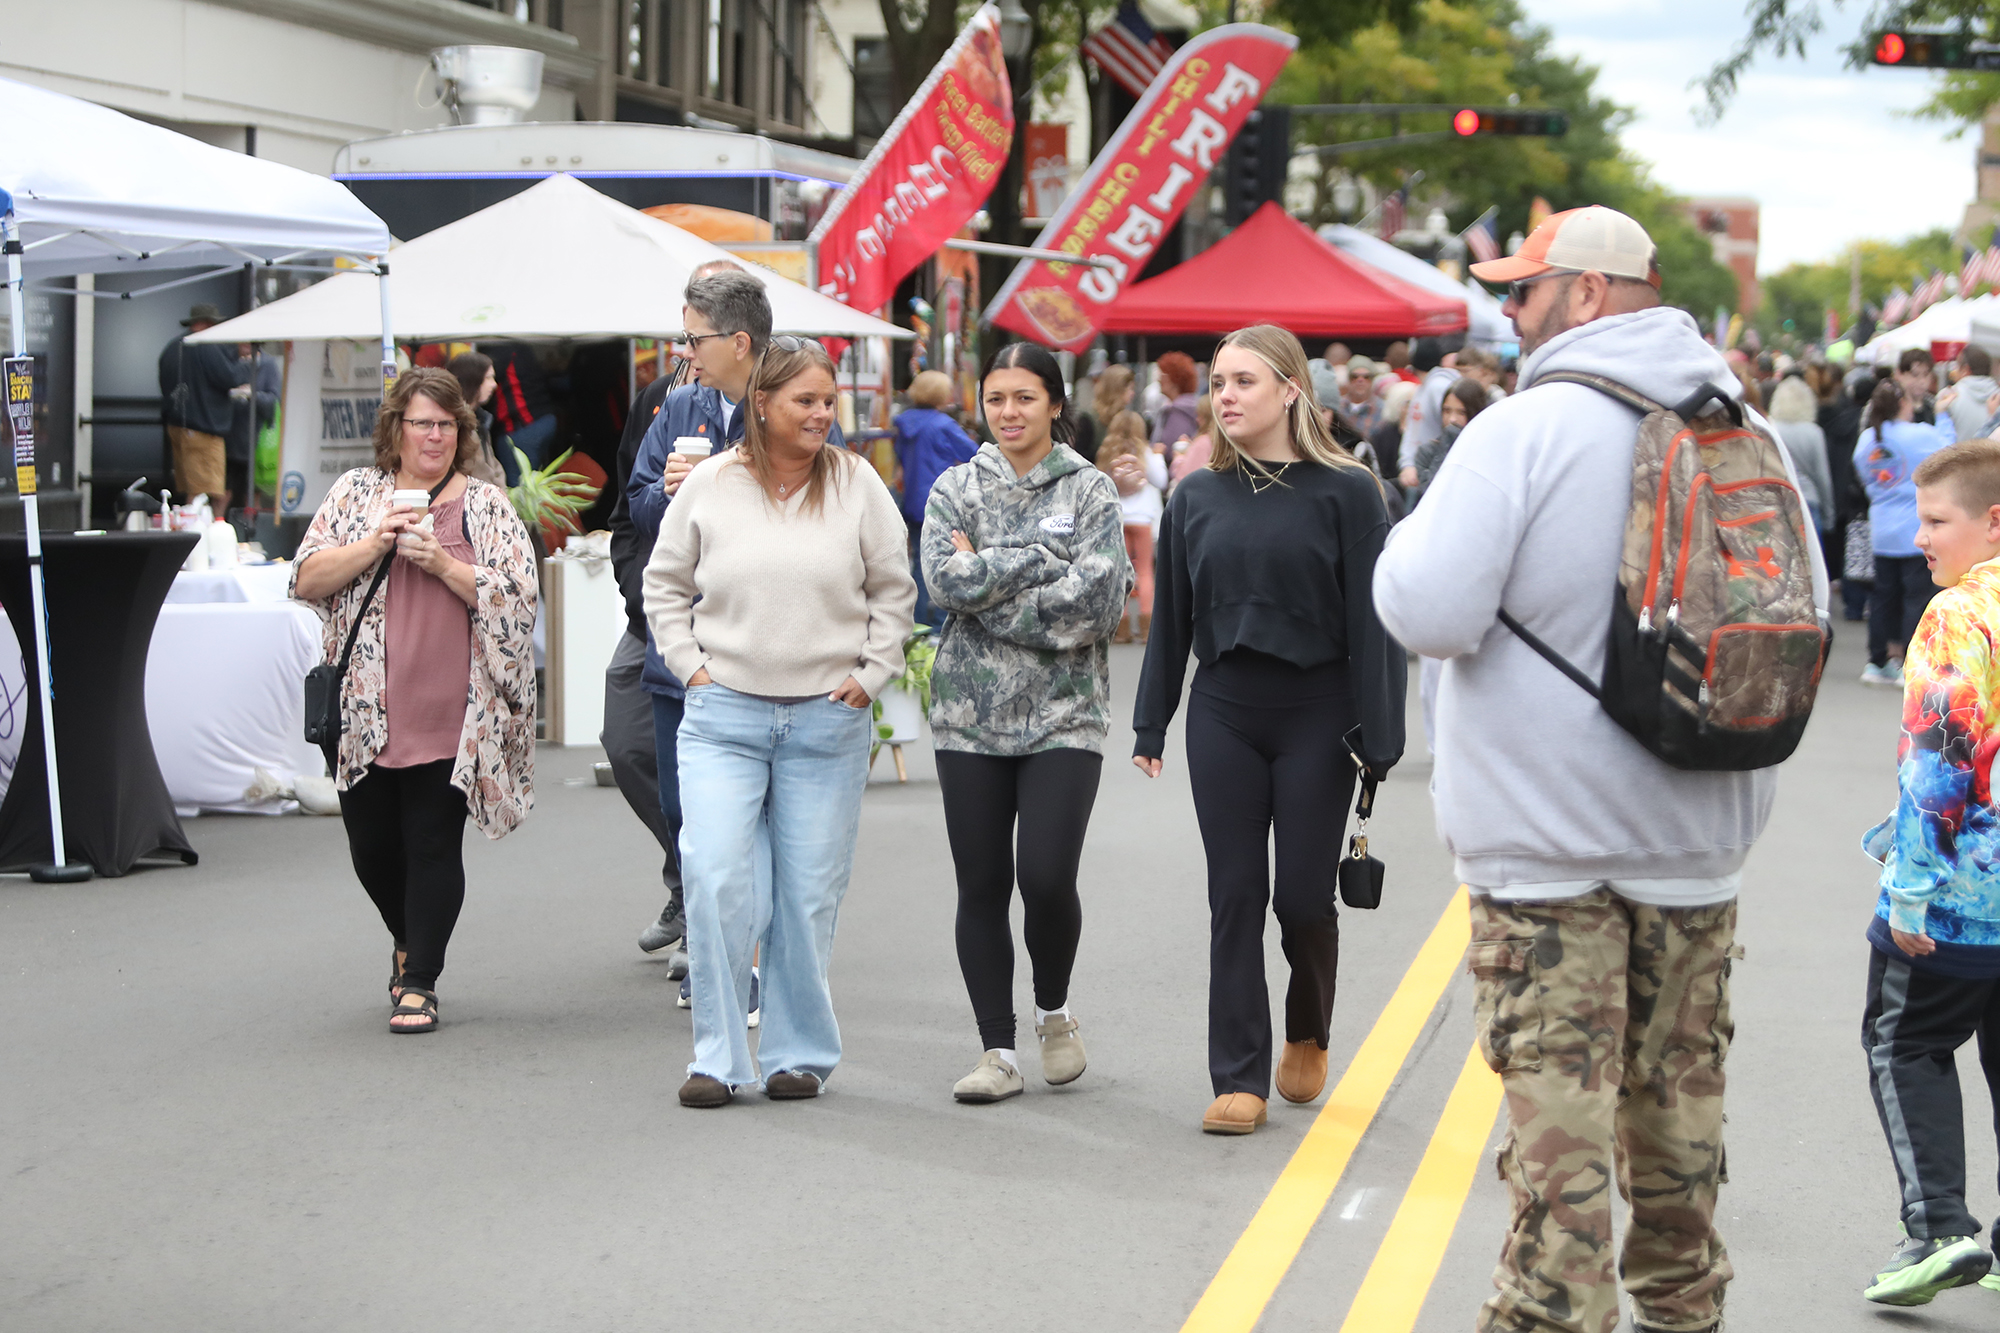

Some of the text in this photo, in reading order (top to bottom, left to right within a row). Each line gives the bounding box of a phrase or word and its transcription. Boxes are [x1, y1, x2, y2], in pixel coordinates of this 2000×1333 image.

[956, 140, 1001, 182] Fried
[1047, 57, 1210, 279] CHILI CHEESE
[1077, 61, 1261, 303] FRIES
